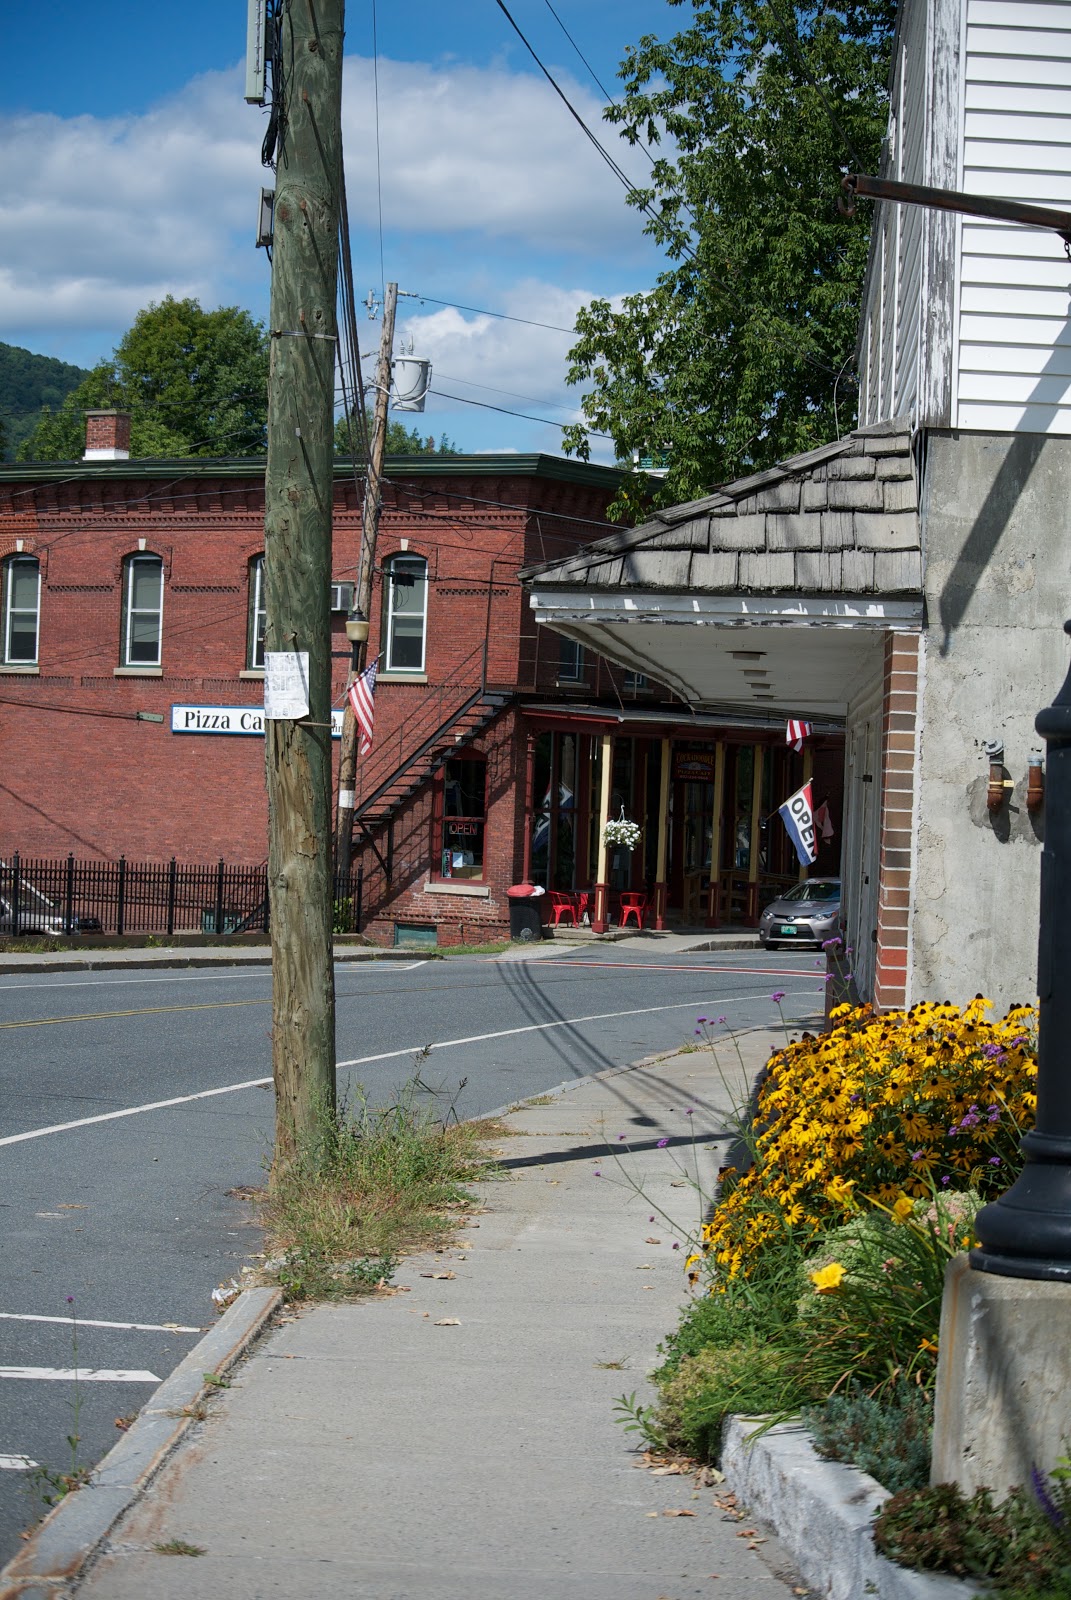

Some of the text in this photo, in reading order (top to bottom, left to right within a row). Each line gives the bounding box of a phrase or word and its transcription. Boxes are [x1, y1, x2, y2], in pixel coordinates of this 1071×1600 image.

[184, 710, 265, 731] Pizza Ca
[450, 823, 476, 834] OPEN
